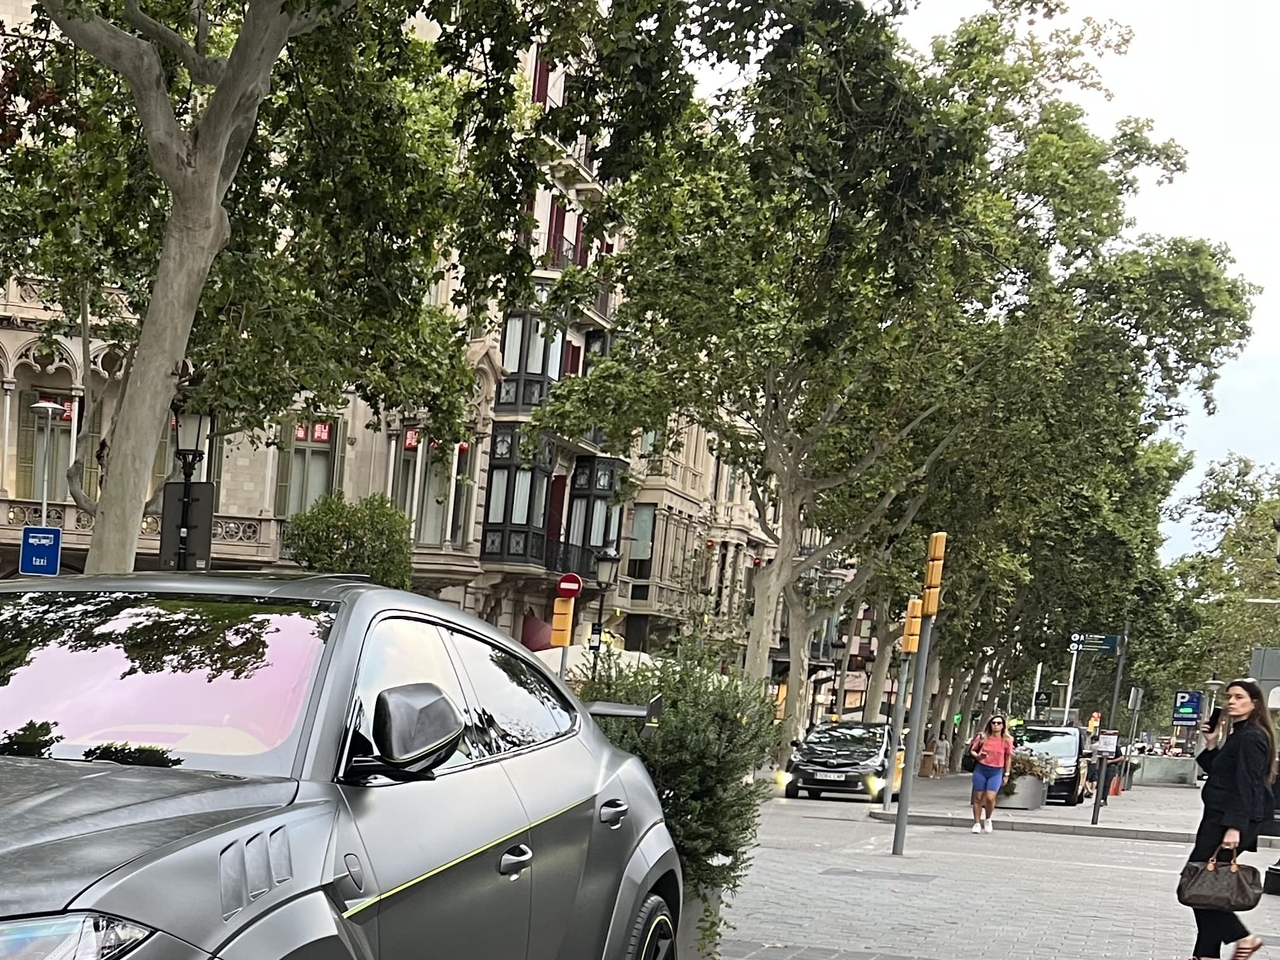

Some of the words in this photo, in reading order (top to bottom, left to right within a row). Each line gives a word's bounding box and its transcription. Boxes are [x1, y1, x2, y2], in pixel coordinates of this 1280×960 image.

[315, 423, 329, 432] EU
[314, 431, 329, 440] FB
[32, 556, 47, 566] taxi
[1175, 692, 1190, 707] P
